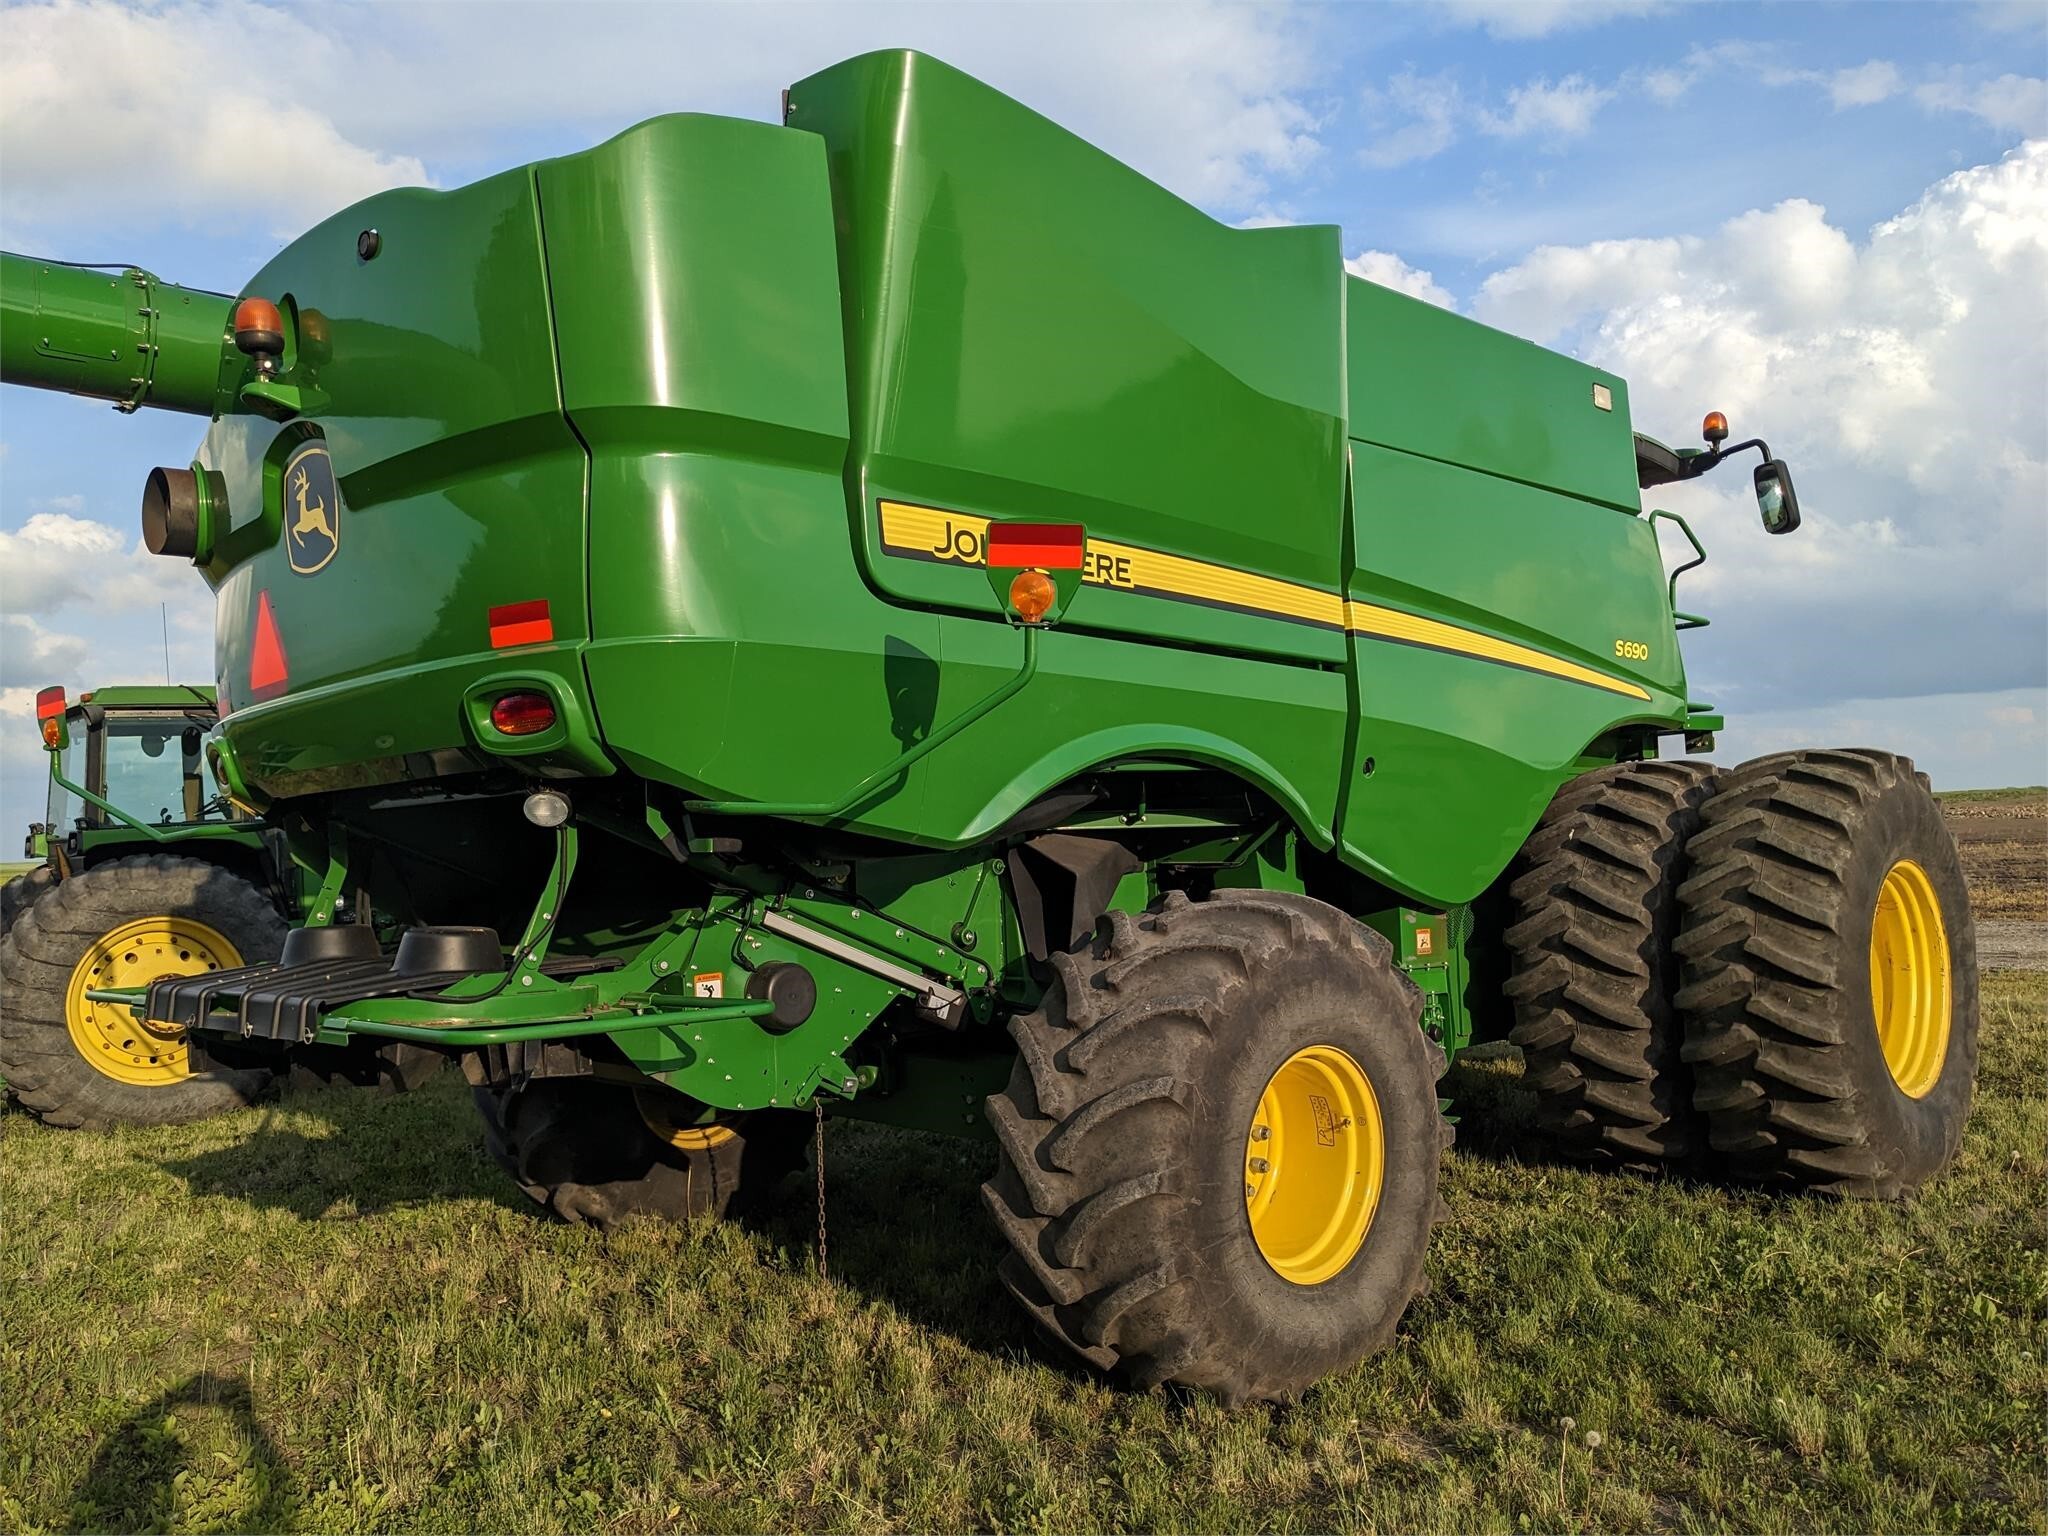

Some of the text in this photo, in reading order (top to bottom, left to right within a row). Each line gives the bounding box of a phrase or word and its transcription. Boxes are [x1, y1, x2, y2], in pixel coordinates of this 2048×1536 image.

[933, 520, 1132, 584] JO ERE
[1615, 639, 1648, 661] S690
